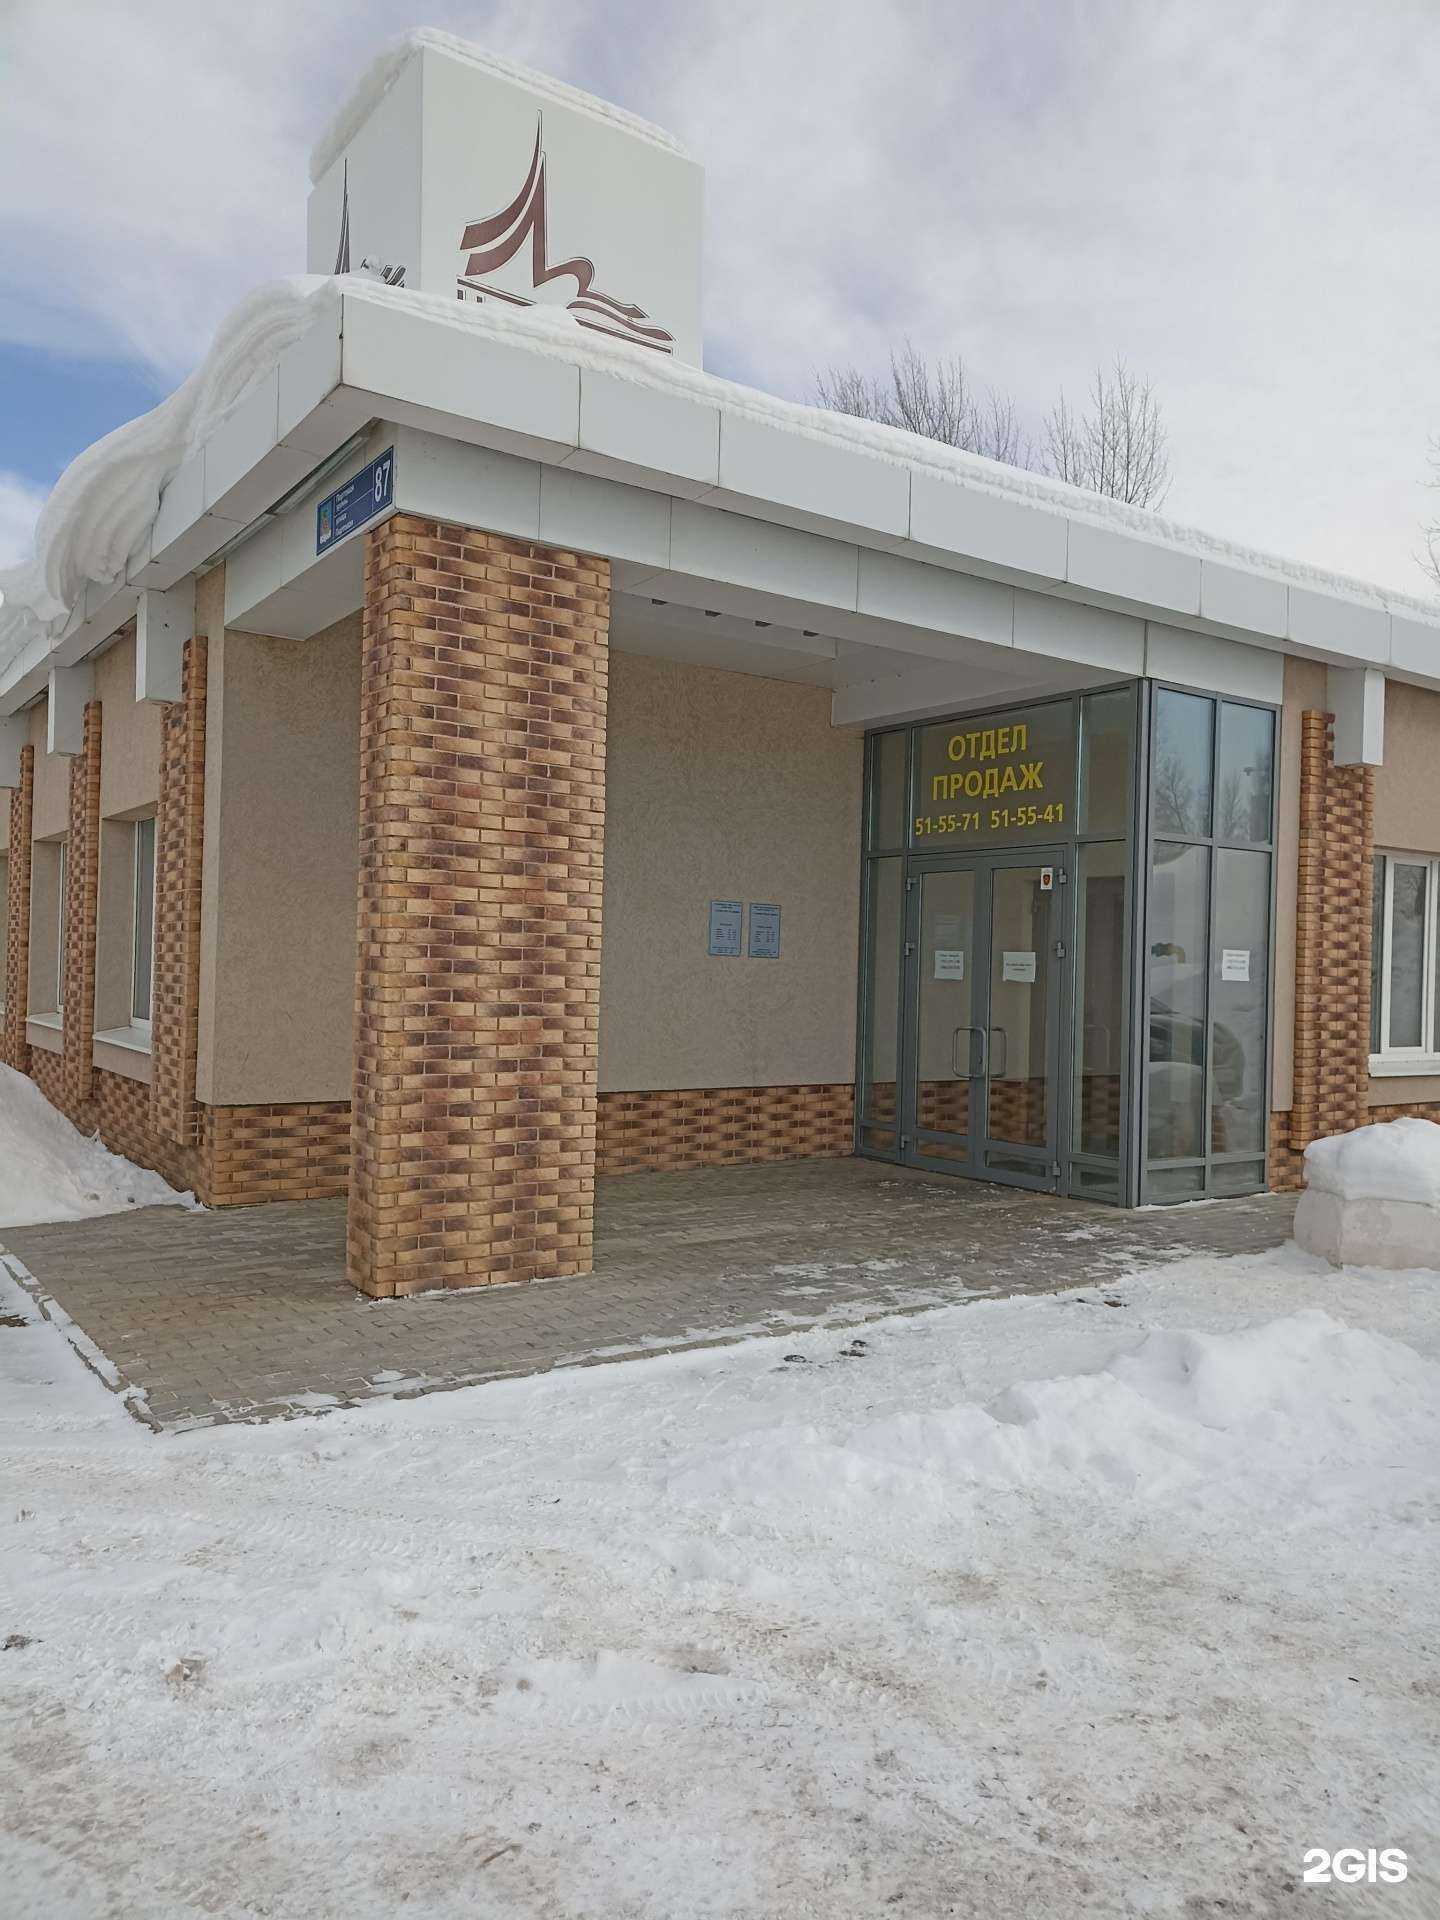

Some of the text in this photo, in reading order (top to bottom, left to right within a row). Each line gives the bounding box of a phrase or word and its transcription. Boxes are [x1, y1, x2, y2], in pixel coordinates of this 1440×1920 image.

[375, 460, 390, 502] 87
[948, 724, 1027, 761] ОТДЕЛ
[932, 762, 1044, 800] ПРОДАЖ
[915, 803, 1064, 836] 51-55-71 51-55-41
